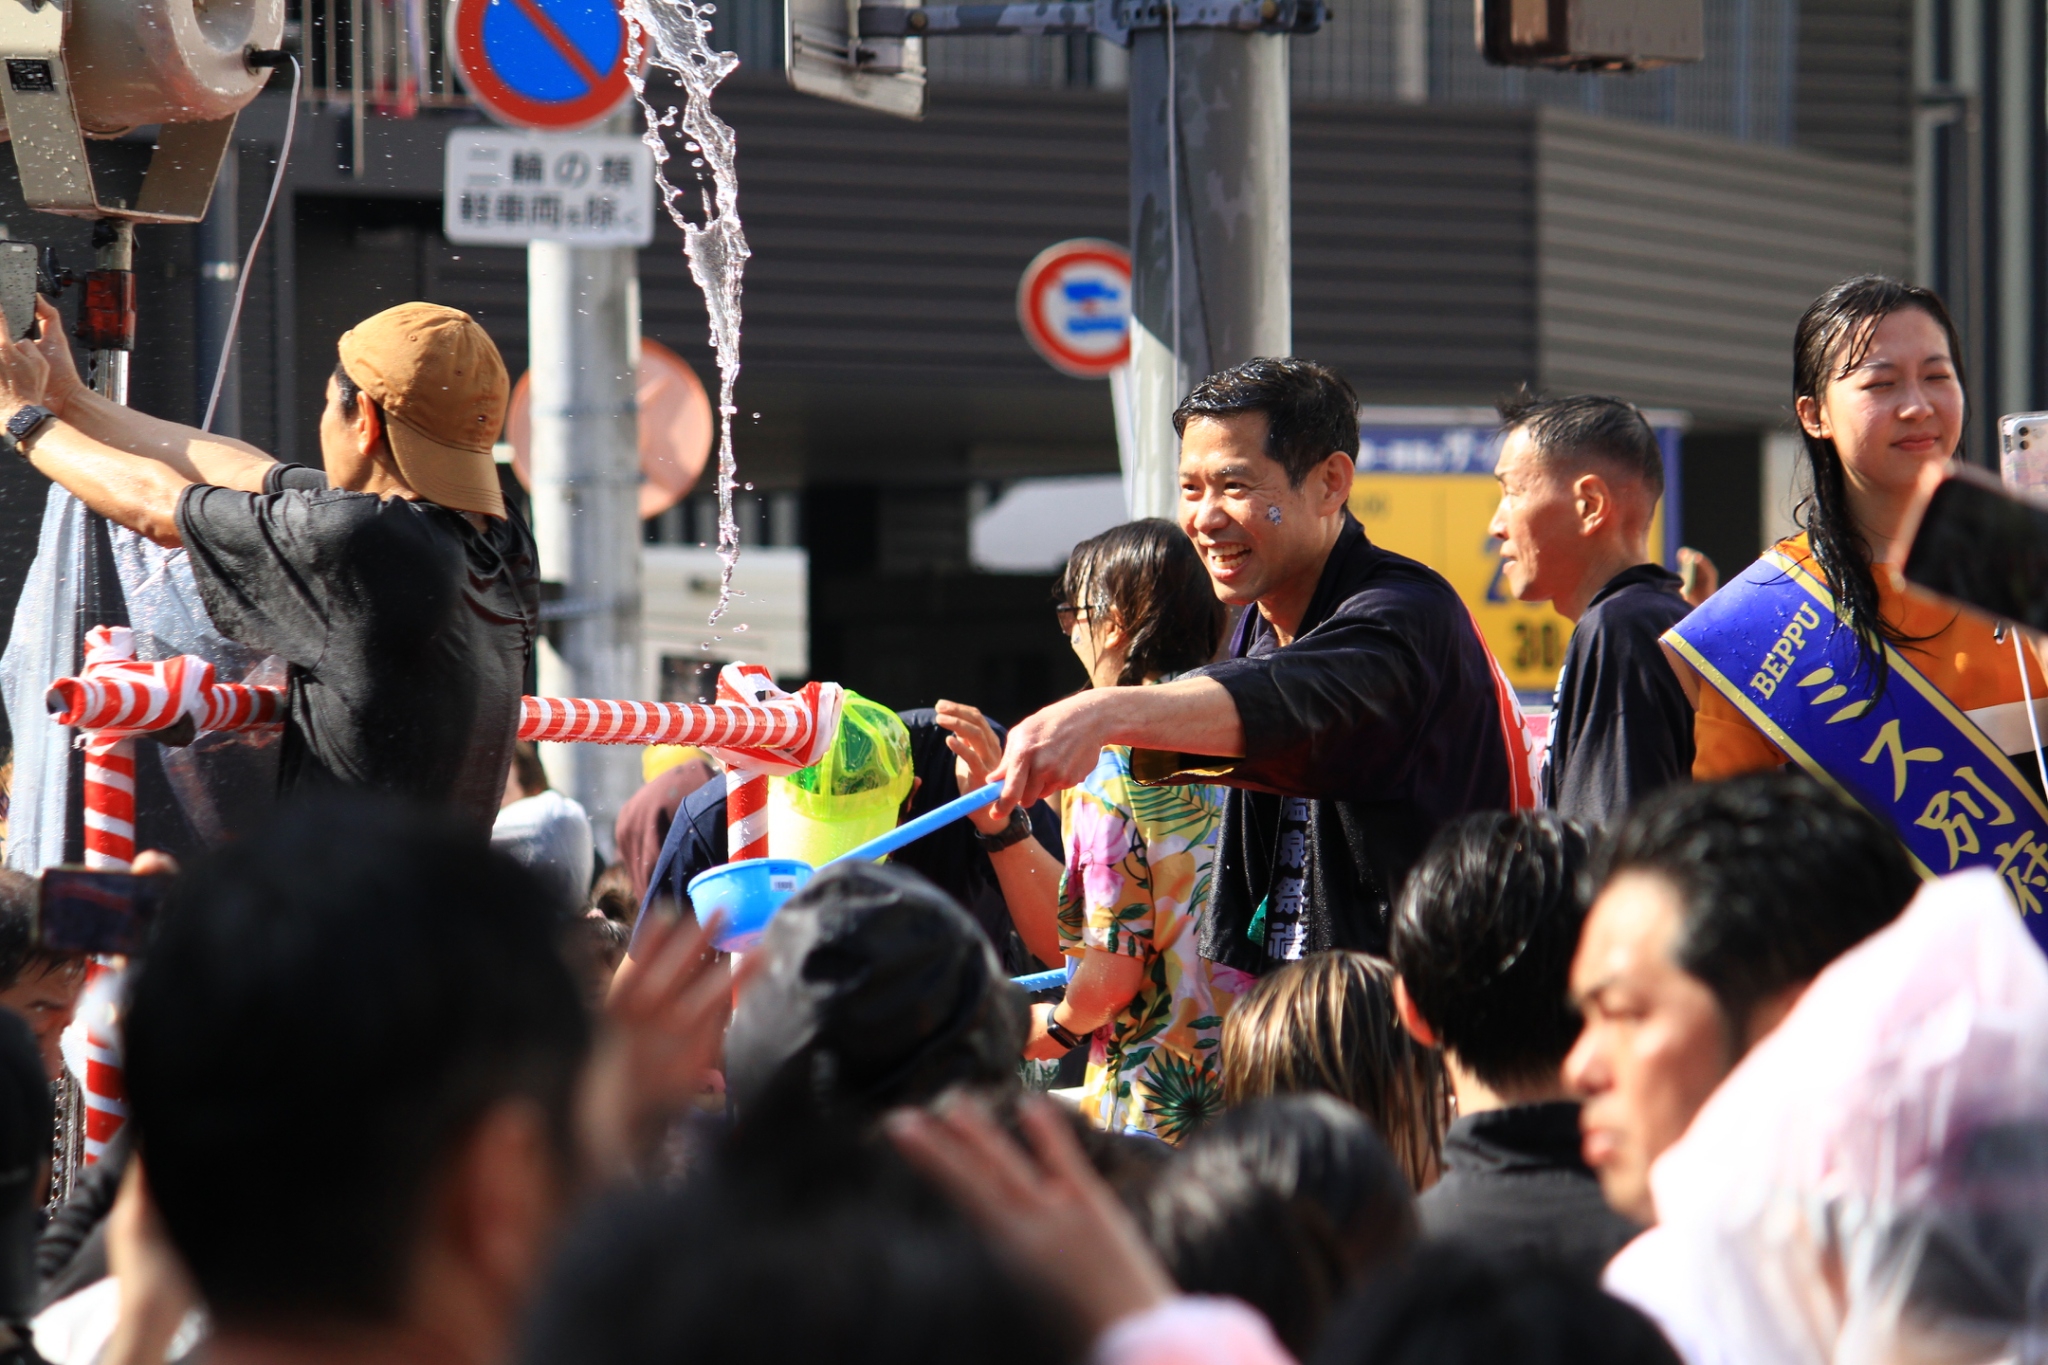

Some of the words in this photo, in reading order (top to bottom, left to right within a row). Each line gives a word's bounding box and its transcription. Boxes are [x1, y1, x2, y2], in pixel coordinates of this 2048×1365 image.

[460, 191, 643, 232] 軽車両を除く
[1749, 601, 1821, 701] BEPPU
[1796, 666, 2048, 917] ミス別府
